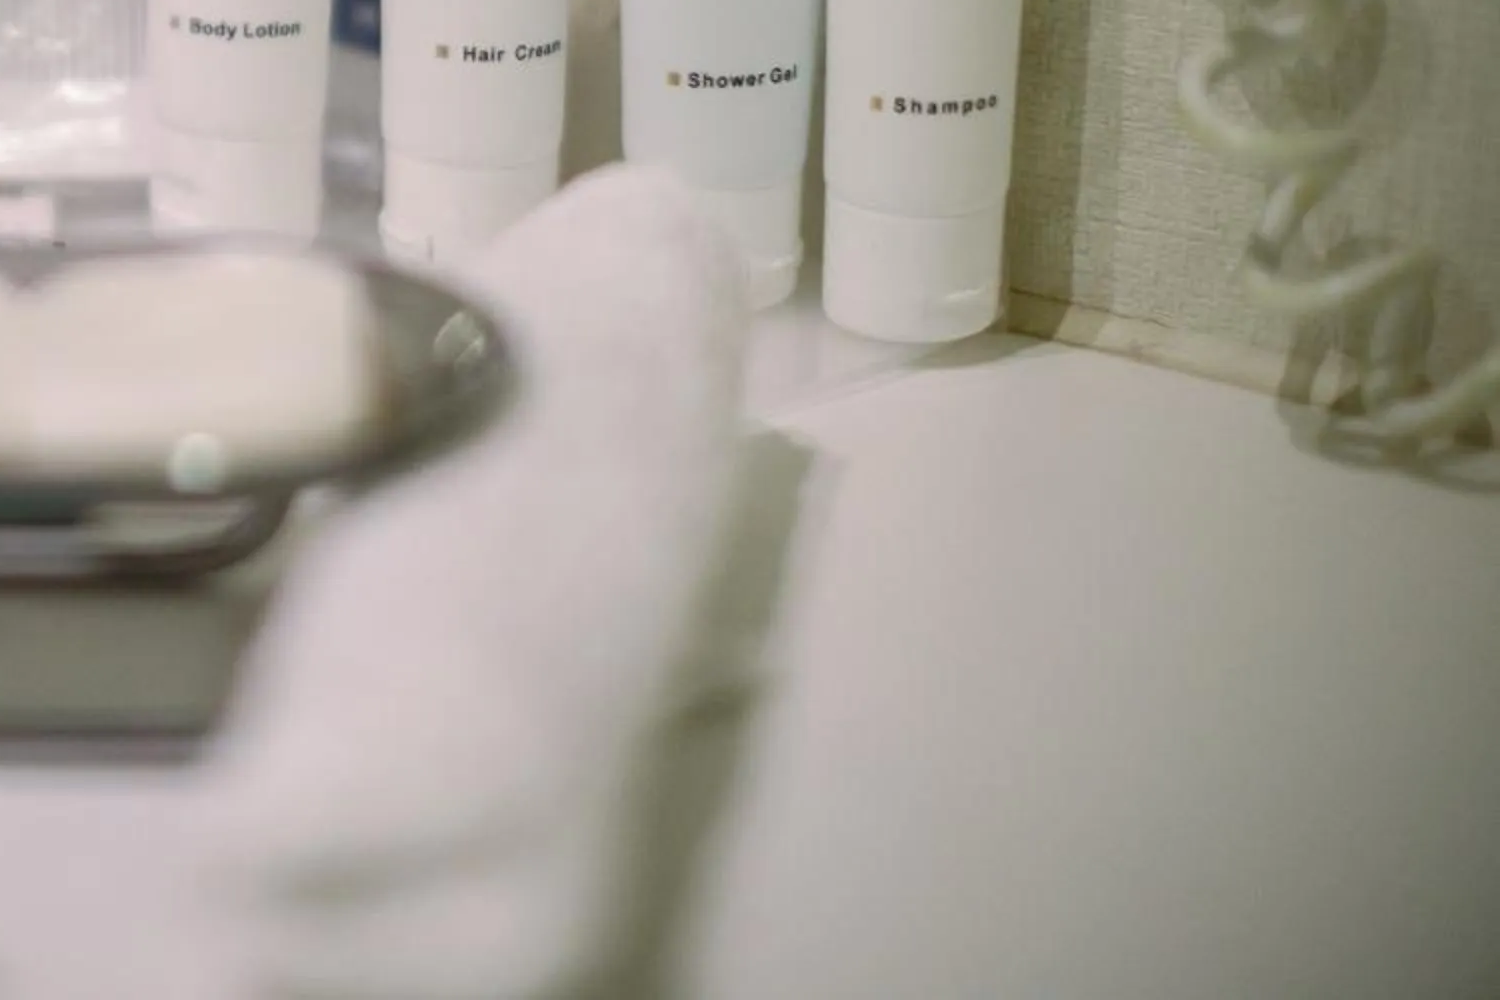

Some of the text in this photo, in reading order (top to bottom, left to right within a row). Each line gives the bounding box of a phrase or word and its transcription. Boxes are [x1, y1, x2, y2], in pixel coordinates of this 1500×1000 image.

[189, 17, 301, 42] Body Lotion
[463, 45, 505, 63] Hair
[688, 63, 798, 89] Shower Gel
[893, 94, 998, 115] Shampoo
